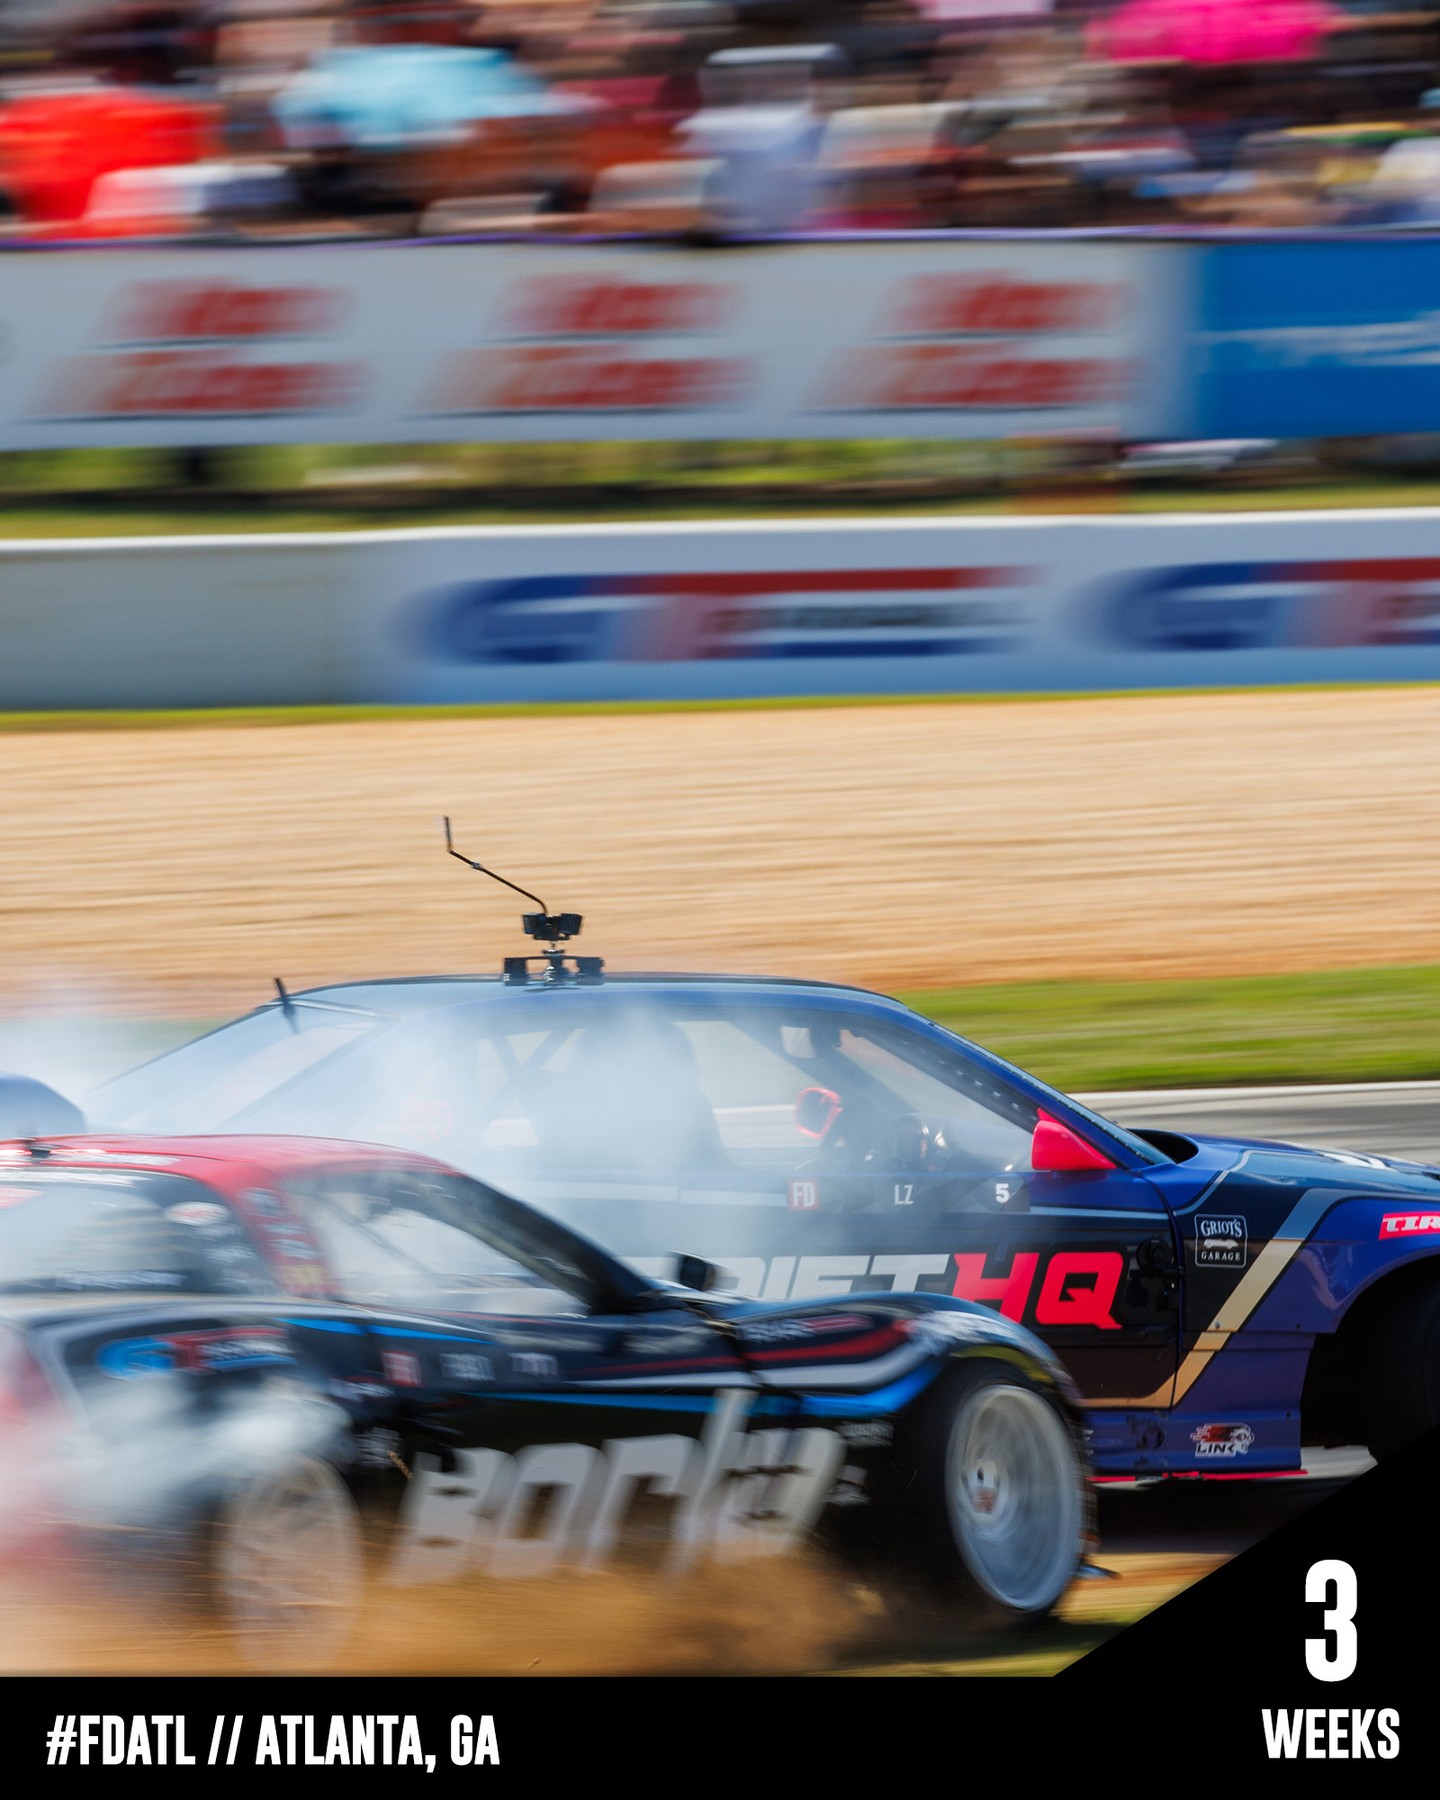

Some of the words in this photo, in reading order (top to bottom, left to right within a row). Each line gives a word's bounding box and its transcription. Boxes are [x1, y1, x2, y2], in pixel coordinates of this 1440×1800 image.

[792, 1181, 816, 1208] FD
[893, 1184, 914, 1205] LZ
[995, 1183, 1010, 1203] 5
[1200, 1218, 1243, 1238] GRIOT'S
[1200, 1251, 1241, 1262] GARAGE
[1196, 1443, 1235, 1454] LINK
